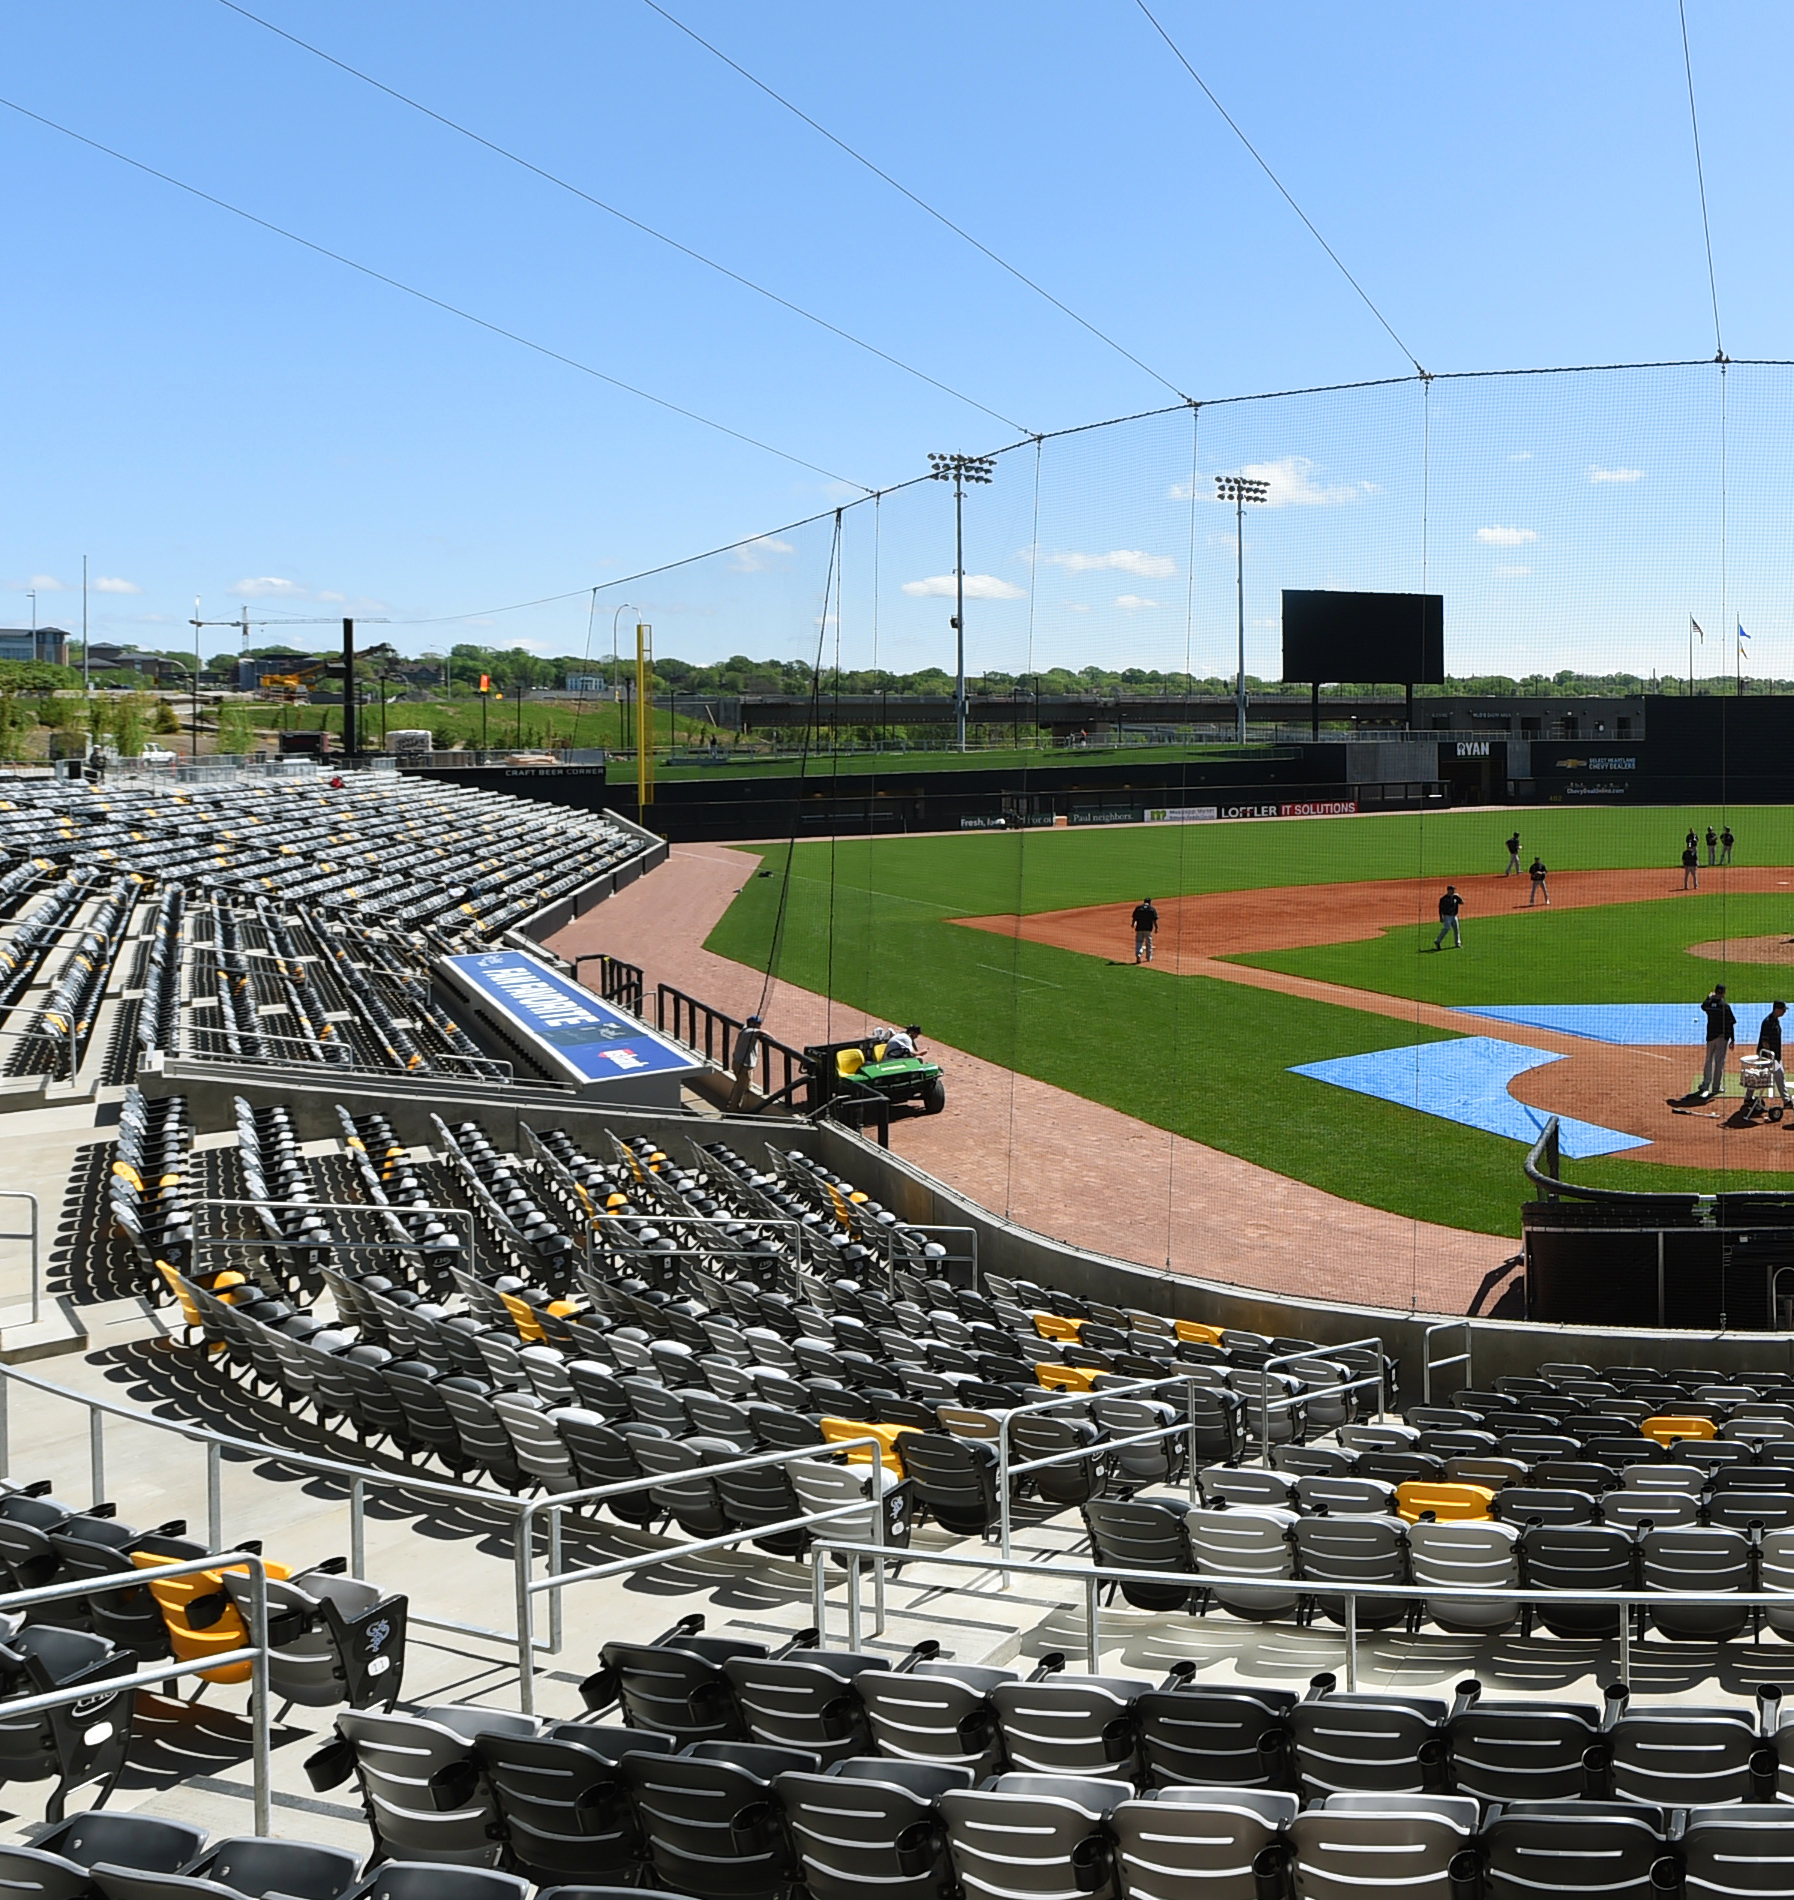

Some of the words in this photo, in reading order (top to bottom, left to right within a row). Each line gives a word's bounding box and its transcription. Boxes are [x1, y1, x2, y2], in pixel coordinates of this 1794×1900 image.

[1456, 742, 1490, 756] RYAN
[505, 769, 536, 777] CRAFT
[538, 768, 563, 776] BEER
[566, 767, 604, 776] CORNER
[1221, 804, 1277, 819] LOFFLER
[1281, 803, 1292, 816] IT
[1294, 802, 1356, 816] SOLUTIONS
[960, 817, 987, 828] Fresh,
[1073, 813, 1091, 823] Paul
[1092, 811, 1134, 824] neighbors.
[482, 967, 541, 985] FAN
[500, 981, 601, 1027] FAVORITE
